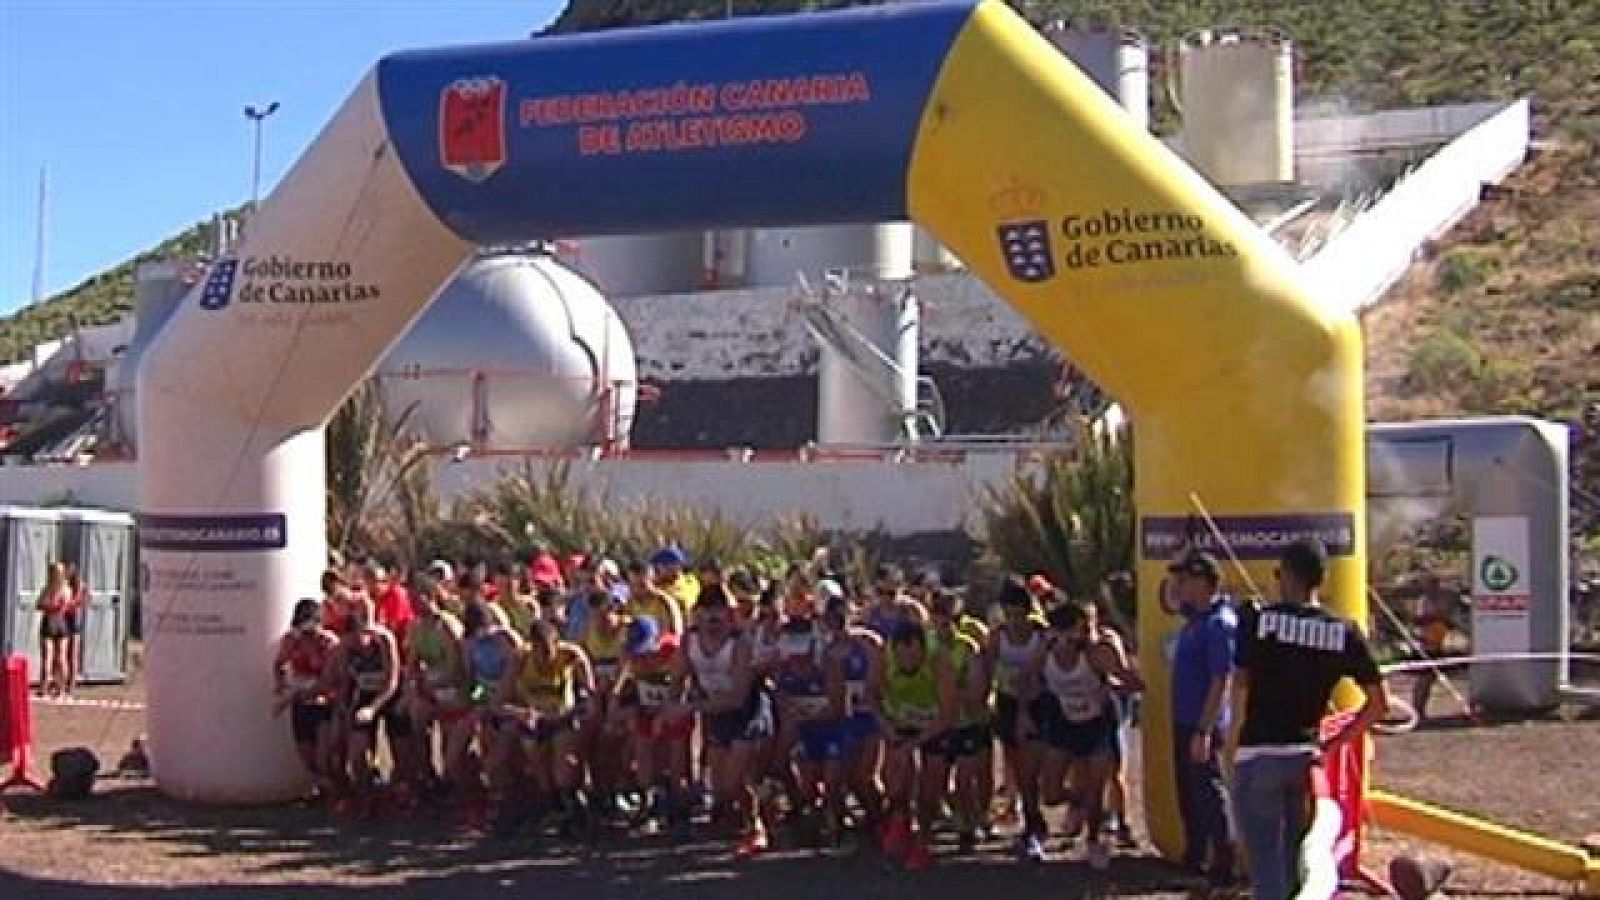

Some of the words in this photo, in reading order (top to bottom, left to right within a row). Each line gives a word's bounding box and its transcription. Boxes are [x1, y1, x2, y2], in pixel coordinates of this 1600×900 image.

[519, 80, 716, 128] FEDERACIÓN
[719, 72, 871, 110] CANARIA
[580, 123, 621, 155] DE
[625, 110, 805, 152] ATLETISMO
[1062, 208, 1204, 239] Gobierno
[242, 255, 352, 277] Gobierno
[1066, 243, 1100, 268] de
[1105, 233, 1237, 264] Canarias
[239, 283, 266, 303] de
[268, 281, 381, 304] Canarias
[1257, 610, 1346, 652] PUMA
